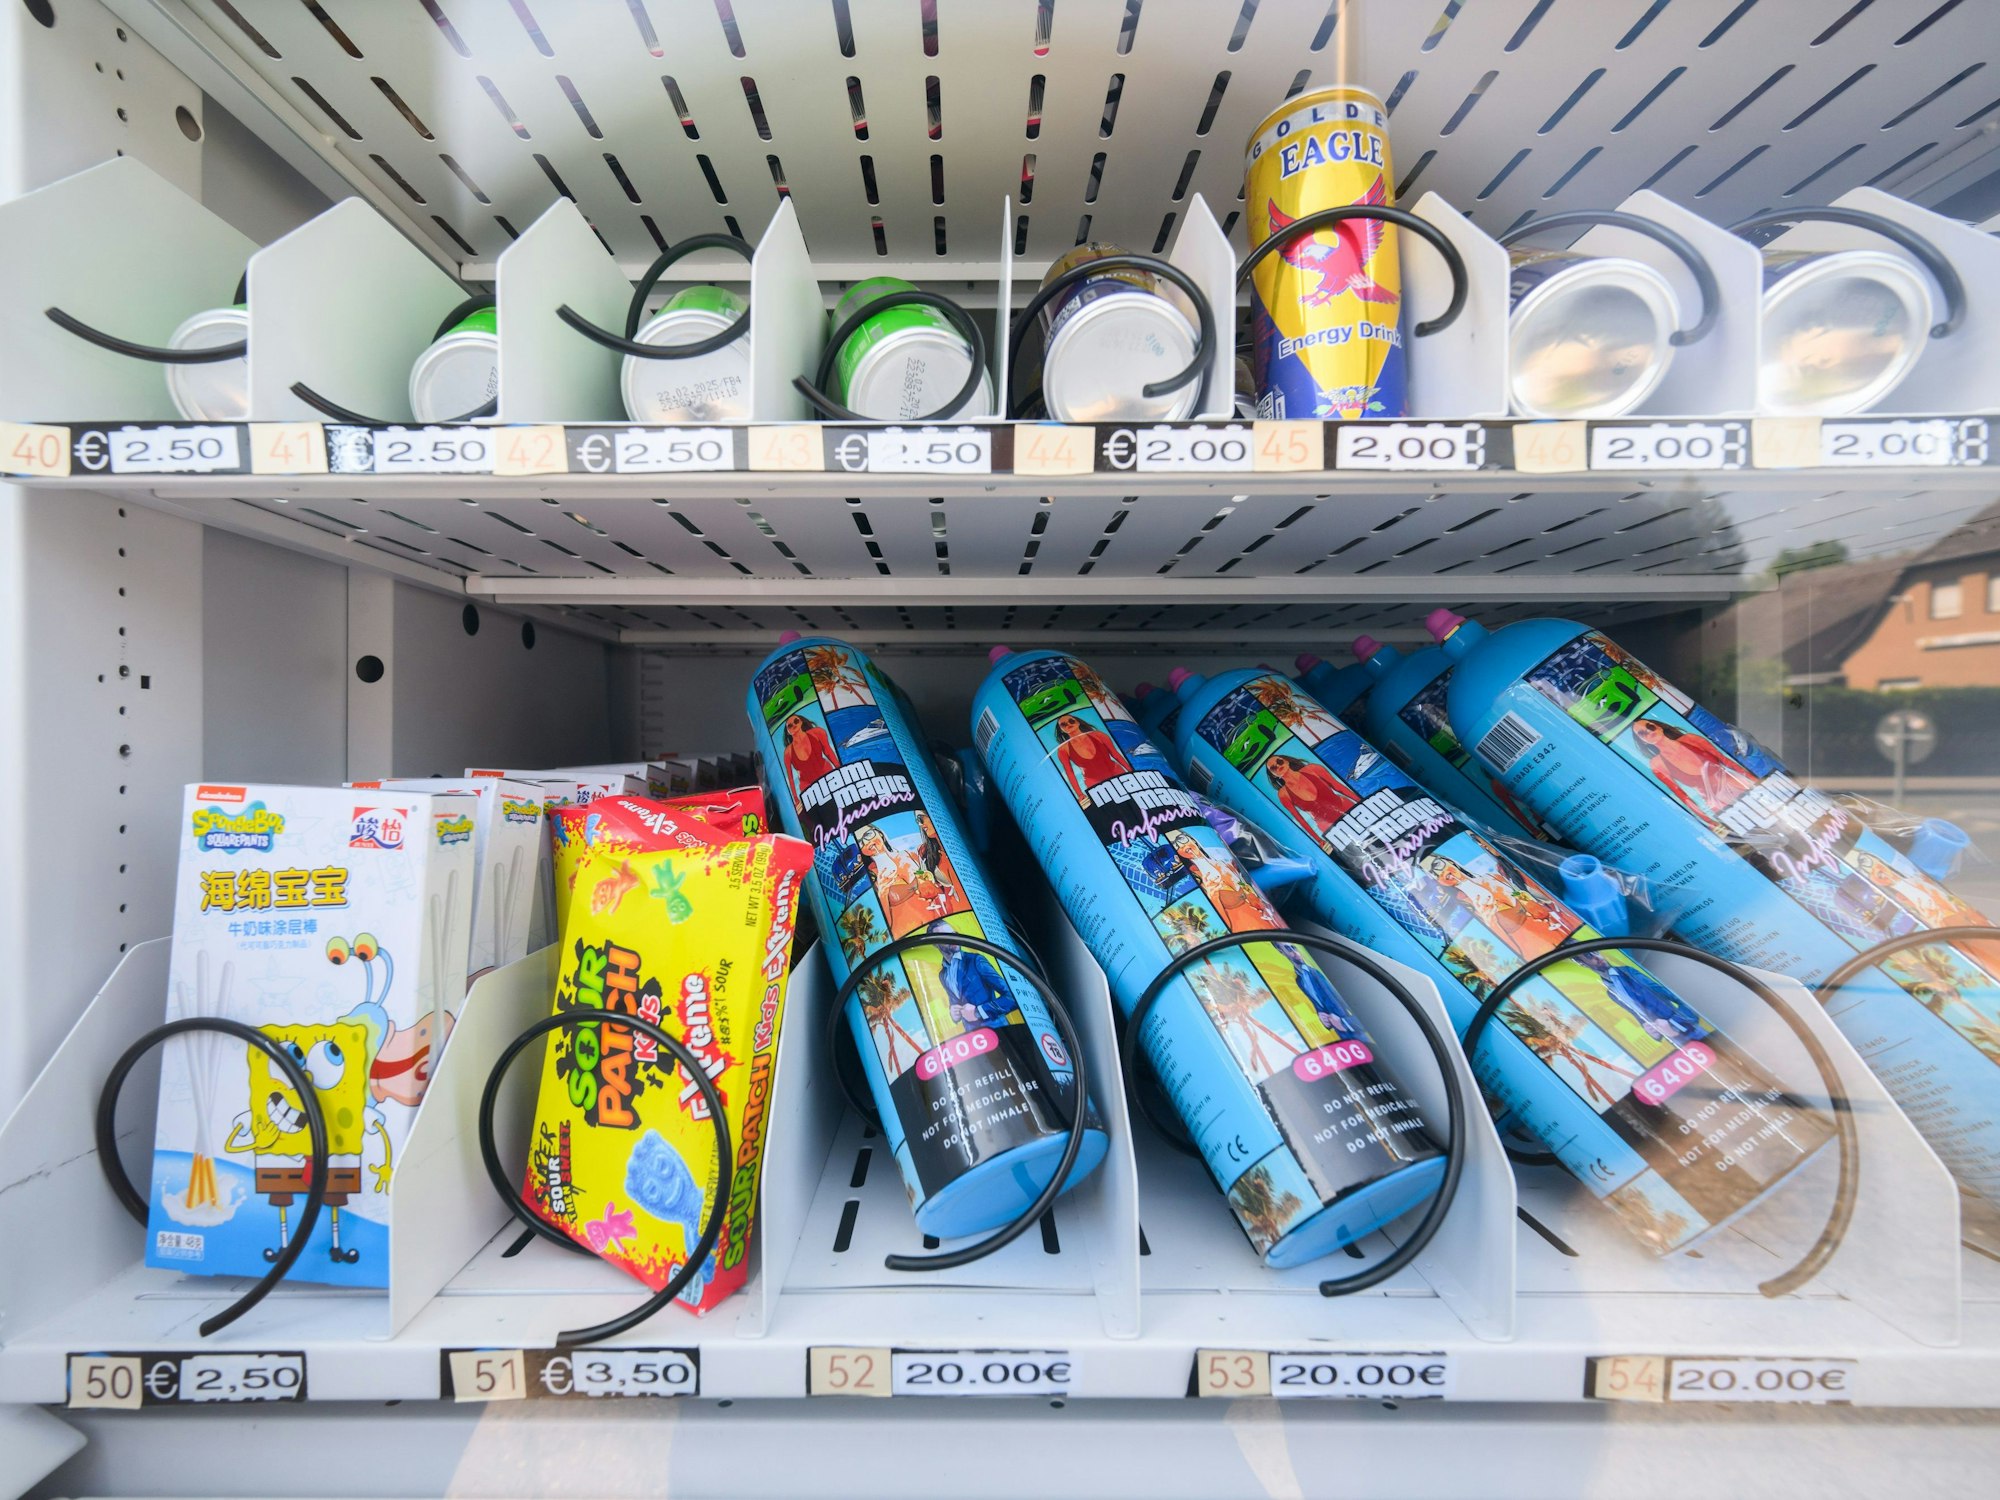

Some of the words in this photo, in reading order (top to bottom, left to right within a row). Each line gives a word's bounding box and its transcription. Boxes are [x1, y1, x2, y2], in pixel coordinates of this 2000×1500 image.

[1252, 104, 1385, 160] GOLDE
[1280, 132, 1384, 179] EAGLE
[1279, 326, 1352, 359] Energy
[1359, 322, 1402, 348] Drink
[12, 434, 61, 467] 40
[124, 437, 223, 463] 2.50
[269, 432, 313, 465] 41
[387, 439, 486, 463] 2.50
[508, 434, 555, 468] 42
[623, 439, 724, 464] 2.50
[764, 433, 811, 467] 43
[1027, 434, 1077, 469] 44
[1146, 438, 1246, 463] 2.00
[1261, 428, 1309, 465] 45
[1352, 435, 1455, 462] 2,00
[1608, 436, 1713, 462] 2,00
[1533, 741, 1557, 765] E942
[814, 790, 915, 851] Infusions
[1610, 814, 1627, 828] UND
[1619, 819, 1651, 845] ANDEREN
[200, 866, 349, 912] 海绵宝宝
[750, 880, 762, 894] 3.5
[752, 867, 764, 879] OZ
[745, 912, 757, 927] NET
[748, 896, 759, 910] WT
[228, 919, 318, 936] 牛奶味涂层棒
[754, 984, 780, 1052] Kids
[924, 1033, 988, 1073] 640G
[1304, 1043, 1366, 1077] 640G
[1644, 1047, 1708, 1098] 640G
[932, 1096, 947, 1111] DO
[975, 1068, 1013, 1089] REFILL
[1324, 1098, 1342, 1114] DO
[1345, 1090, 1365, 1108] NOT
[1368, 1082, 1398, 1099] REFILL
[738, 1053, 771, 1166] PATCH
[922, 1124, 940, 1141] NOT
[966, 1088, 1016, 1114] MEDICAL
[943, 1134, 958, 1149] DO
[962, 1121, 984, 1139] NOT
[988, 1102, 1030, 1126] INHALE
[1678, 1119, 1697, 1135] DO
[1697, 1103, 1719, 1124] NOT
[1314, 1126, 1338, 1144] NOT
[1341, 1114, 1364, 1131] FOR
[1347, 1139, 1365, 1154] DO
[1367, 1129, 1389, 1145] NOT
[1678, 1149, 1703, 1167] NOT
[1704, 1129, 1727, 1150] FOR
[1768, 1086, 1783, 1101] USE
[1715, 1155, 1734, 1172] DO
[1736, 1136, 1760, 1157] NOT
[548, 1157, 566, 1214] SOUR
[723, 1162, 757, 1270] SOUR
[87, 1364, 134, 1399] 50
[196, 1366, 301, 1395] 2,50
[476, 1357, 520, 1393] 51
[586, 1361, 690, 1389] 3,50
[827, 1353, 875, 1388] 52
[905, 1361, 1072, 1387] 20.00€
[1208, 1355, 1257, 1388] 53
[1280, 1363, 1447, 1387] 20.00€
[1609, 1357, 1657, 1393] 54
[1677, 1369, 1847, 1392] 20.00€
